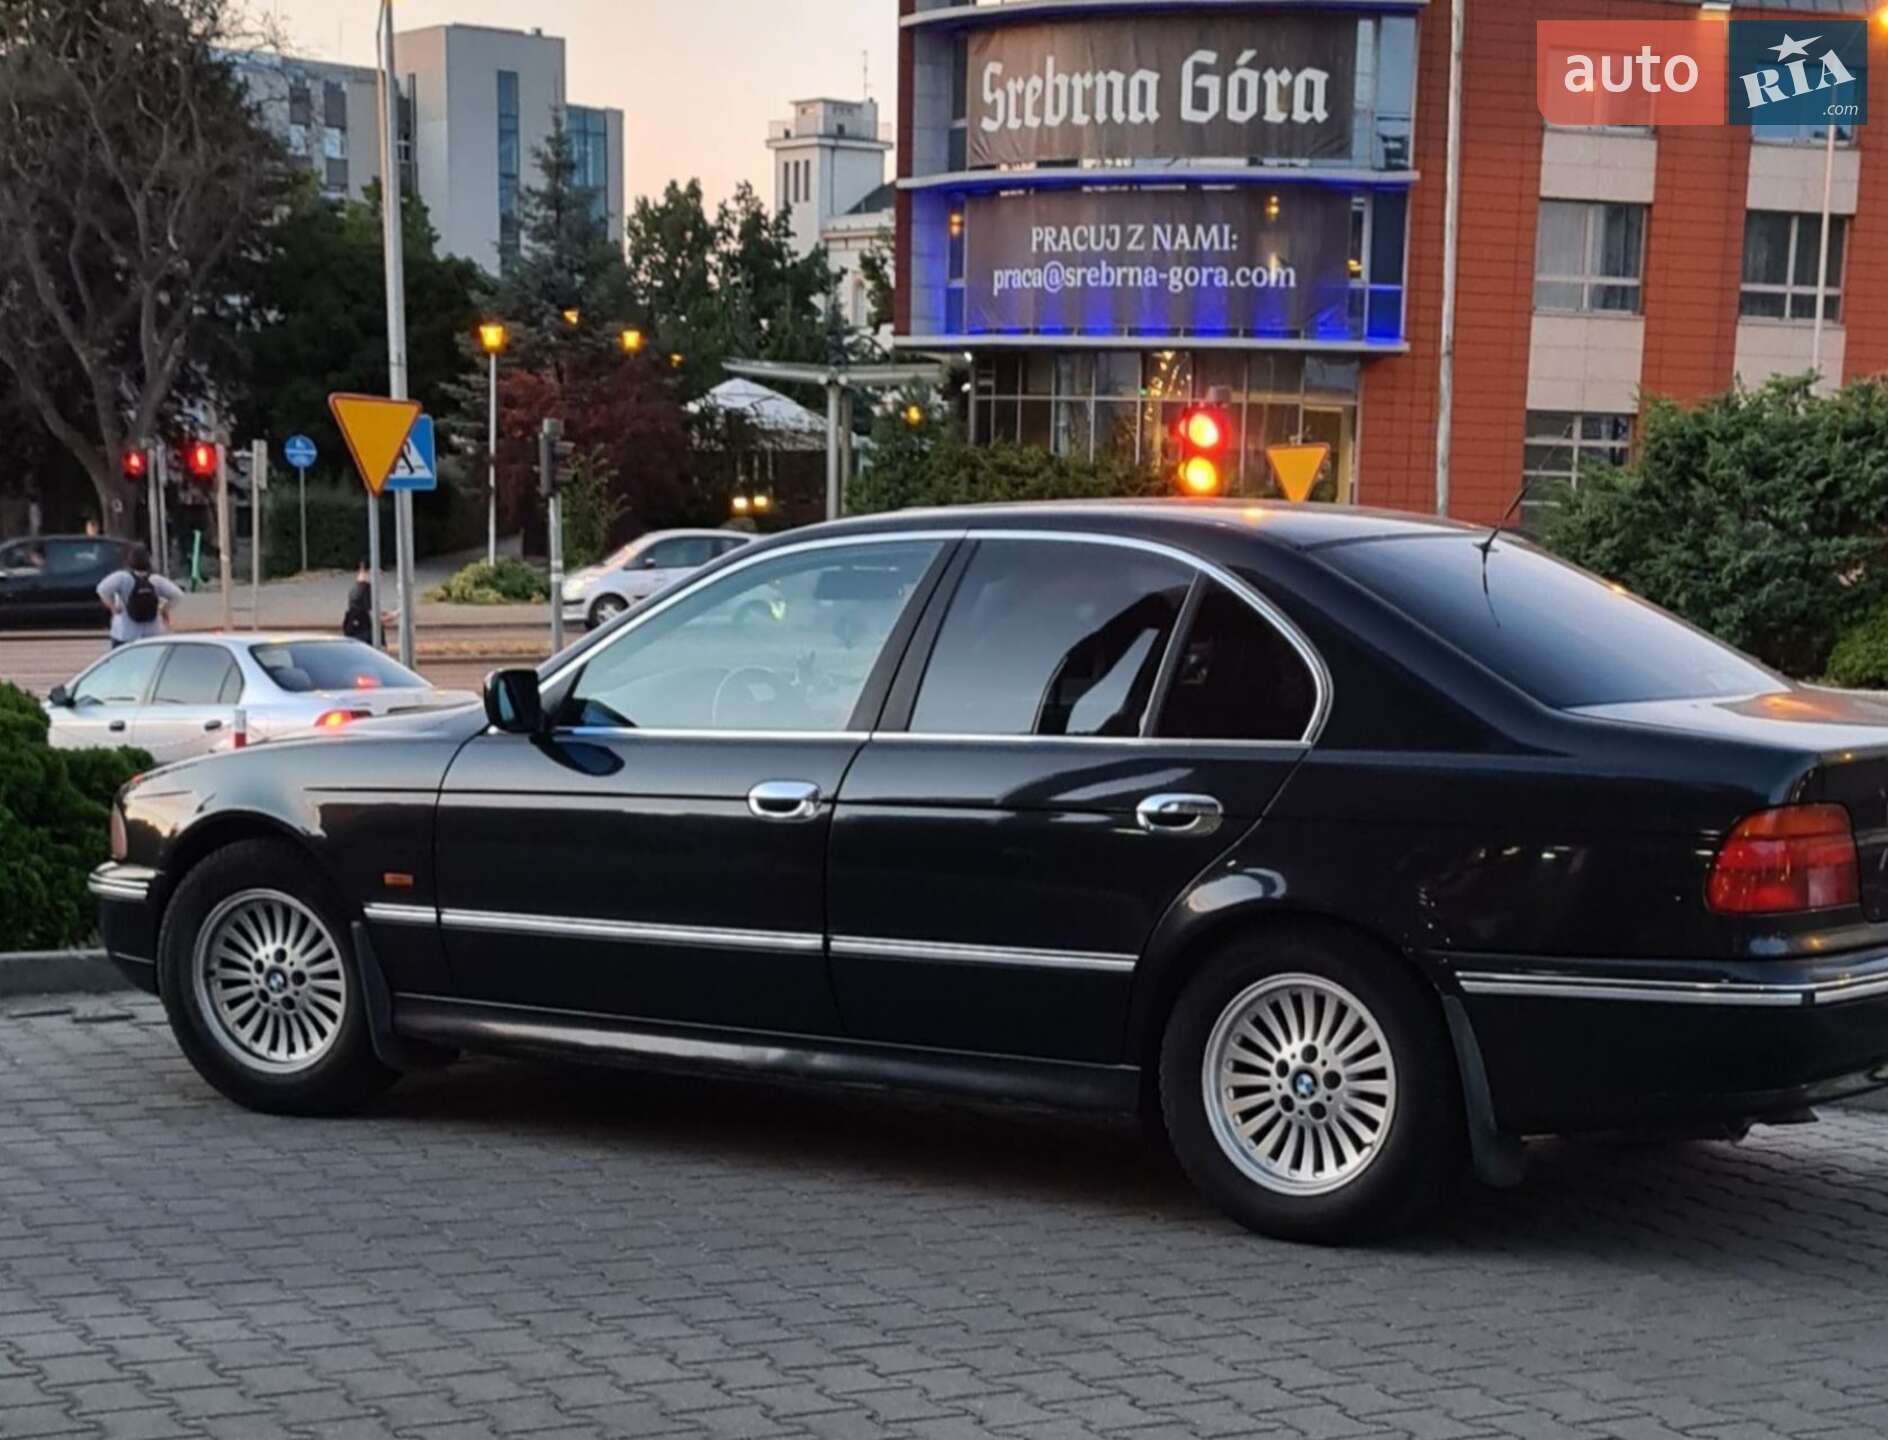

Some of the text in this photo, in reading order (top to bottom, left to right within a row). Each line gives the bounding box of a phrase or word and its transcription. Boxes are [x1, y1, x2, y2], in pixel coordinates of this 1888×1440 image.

[981, 50, 1330, 132] Srebrna Góra
[1031, 224, 1238, 253] PRACUJ Z NAMI:
[992, 262, 1297, 296] praca@srebrna-gora.com
